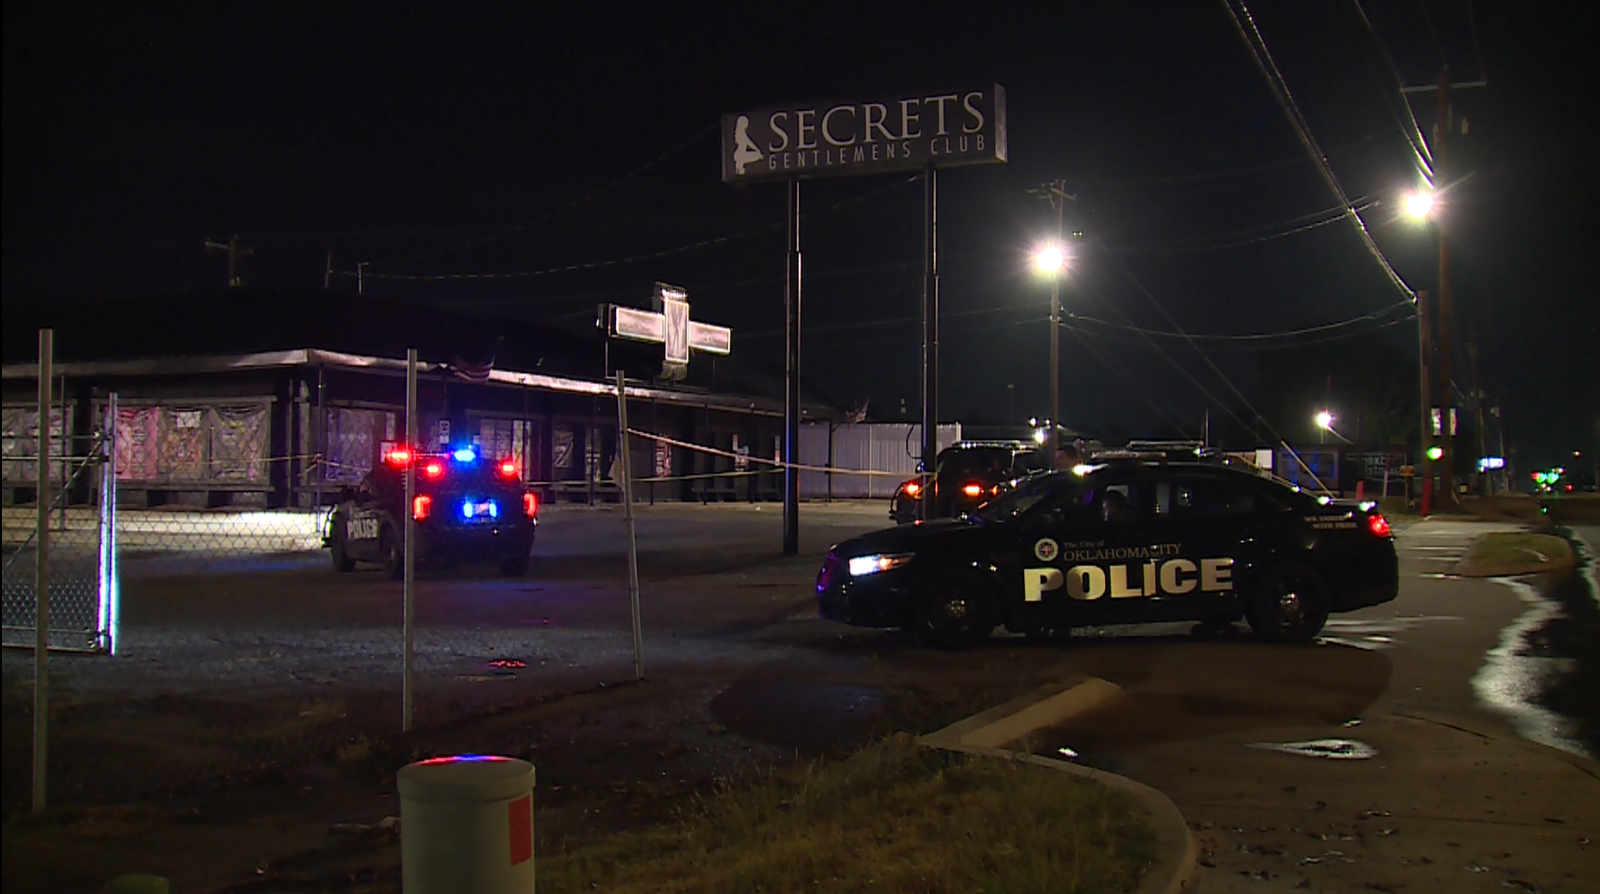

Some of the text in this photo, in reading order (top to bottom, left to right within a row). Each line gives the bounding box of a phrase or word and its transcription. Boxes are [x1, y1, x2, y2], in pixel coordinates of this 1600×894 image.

[769, 90, 985, 152] SECRETS
[768, 134, 985, 170] GENTLEMENS CLUB
[347, 518, 379, 540] POLICE
[1063, 546, 1150, 562] OKLAHOMA
[1064, 541, 1077, 549] The
[1022, 556, 1234, 603] POLICE
